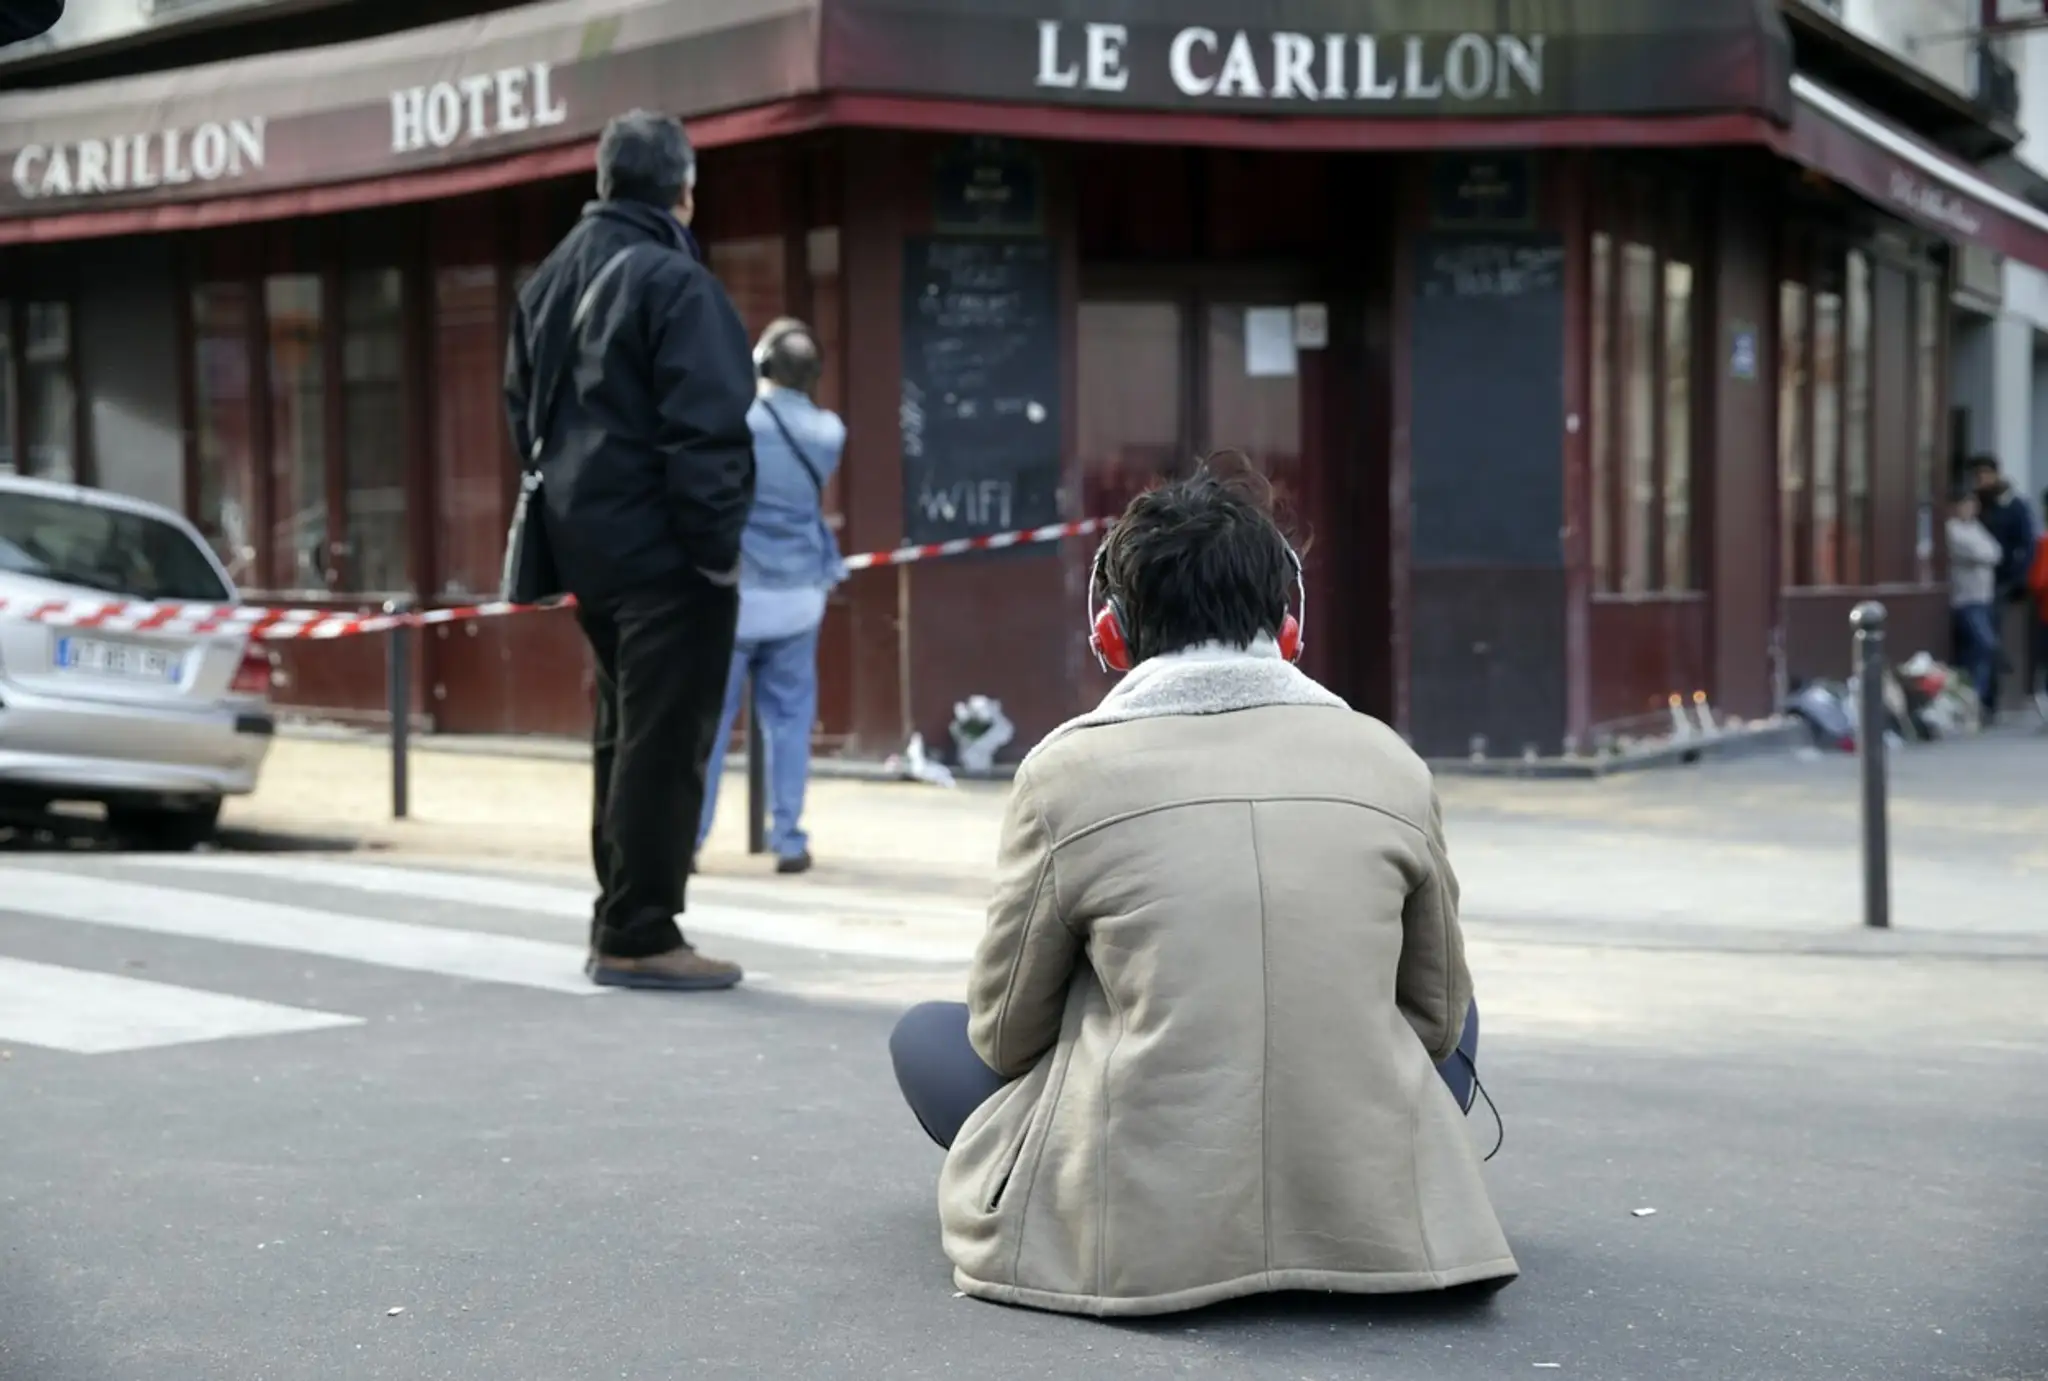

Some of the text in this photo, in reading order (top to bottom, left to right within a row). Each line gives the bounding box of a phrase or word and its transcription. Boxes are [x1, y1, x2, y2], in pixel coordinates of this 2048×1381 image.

[1036, 19, 1546, 101] LE CARILLON
[12, 61, 567, 199] CARILLON HOTEL
